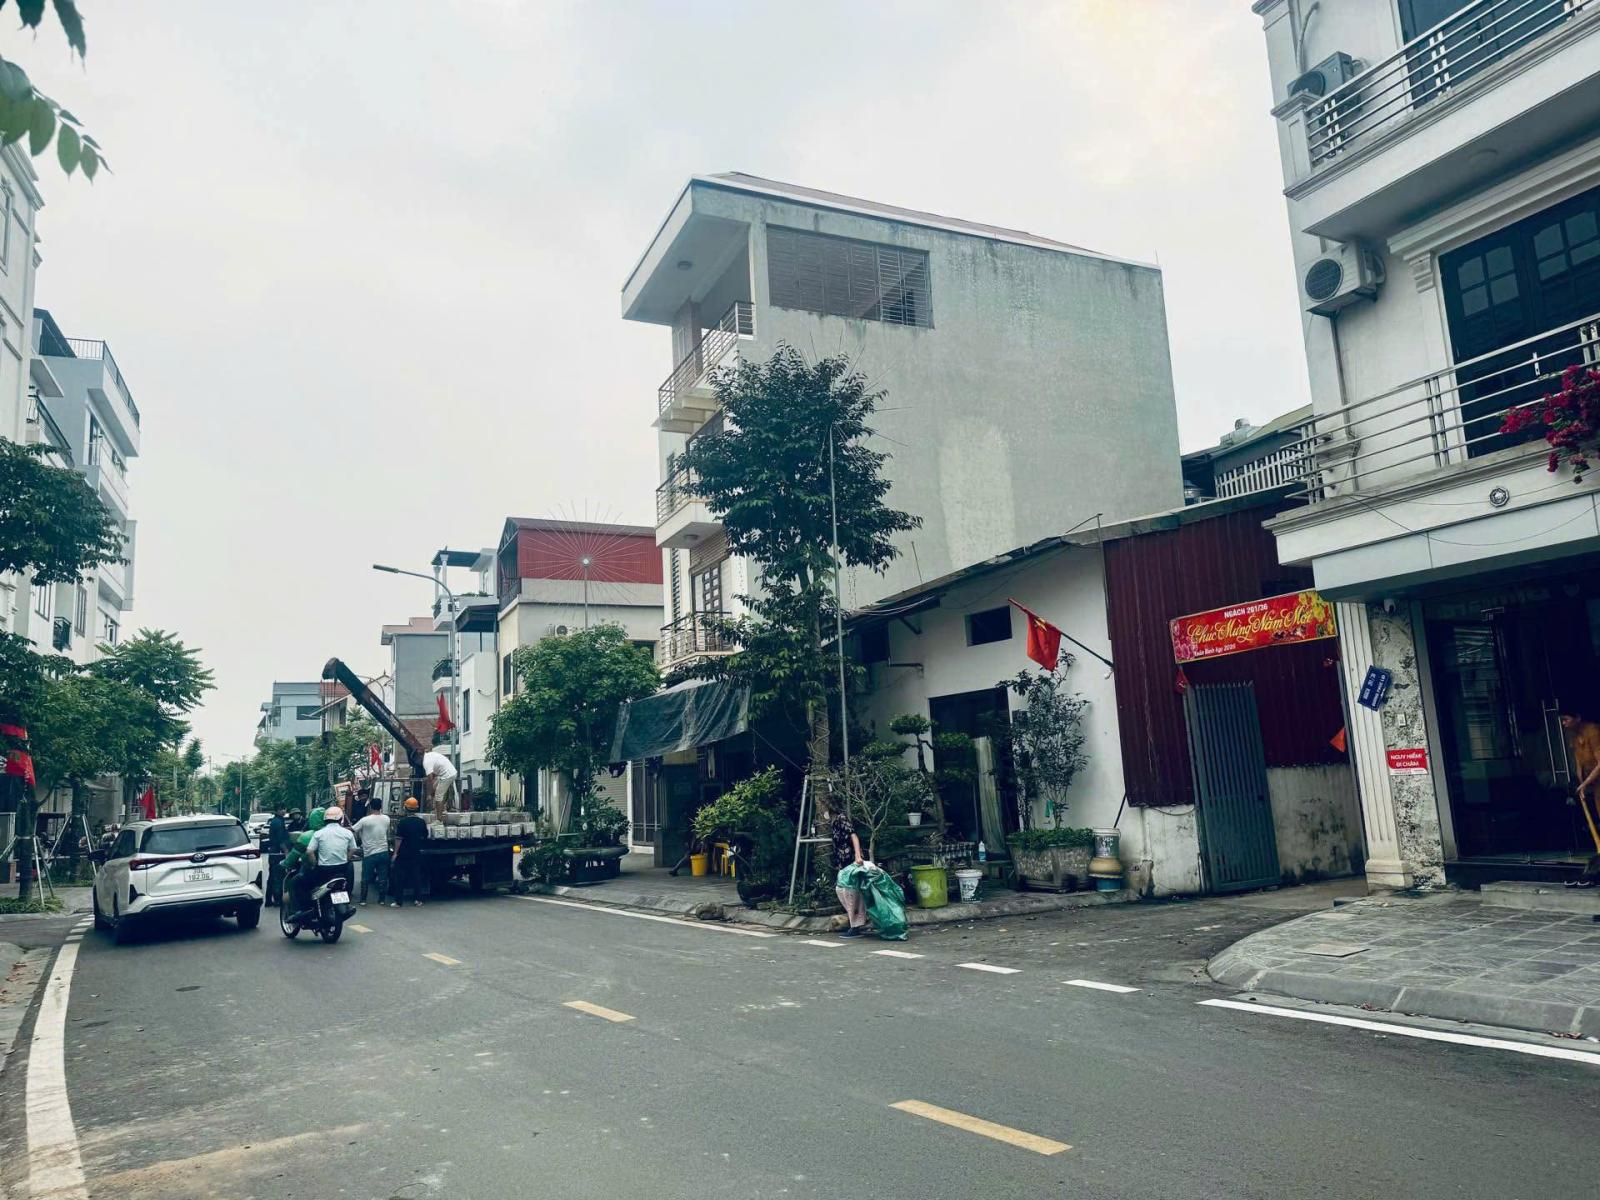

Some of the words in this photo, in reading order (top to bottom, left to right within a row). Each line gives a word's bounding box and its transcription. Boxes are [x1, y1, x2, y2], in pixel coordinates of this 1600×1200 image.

[1187, 623, 1217, 644] Chúc
[1214, 618, 1252, 642] Mừng
[1249, 610, 1283, 633] Năm
